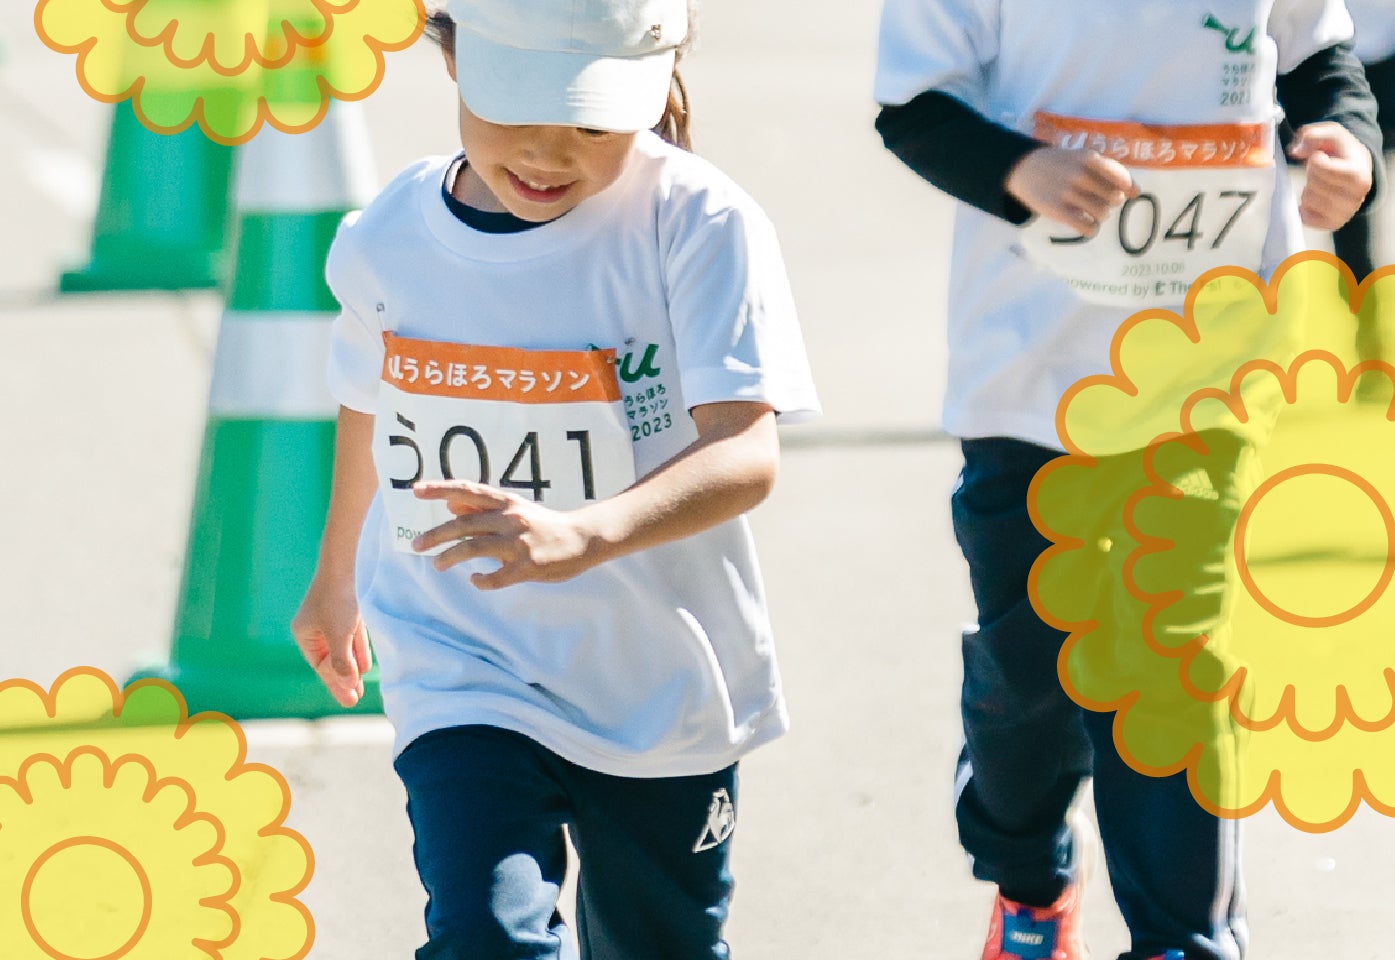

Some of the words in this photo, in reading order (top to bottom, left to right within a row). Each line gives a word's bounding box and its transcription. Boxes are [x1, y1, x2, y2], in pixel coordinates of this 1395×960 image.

[1050, 190, 1257, 258] 047
[403, 357, 590, 392] うらほろマラソン
[631, 413, 672, 442] 2023
